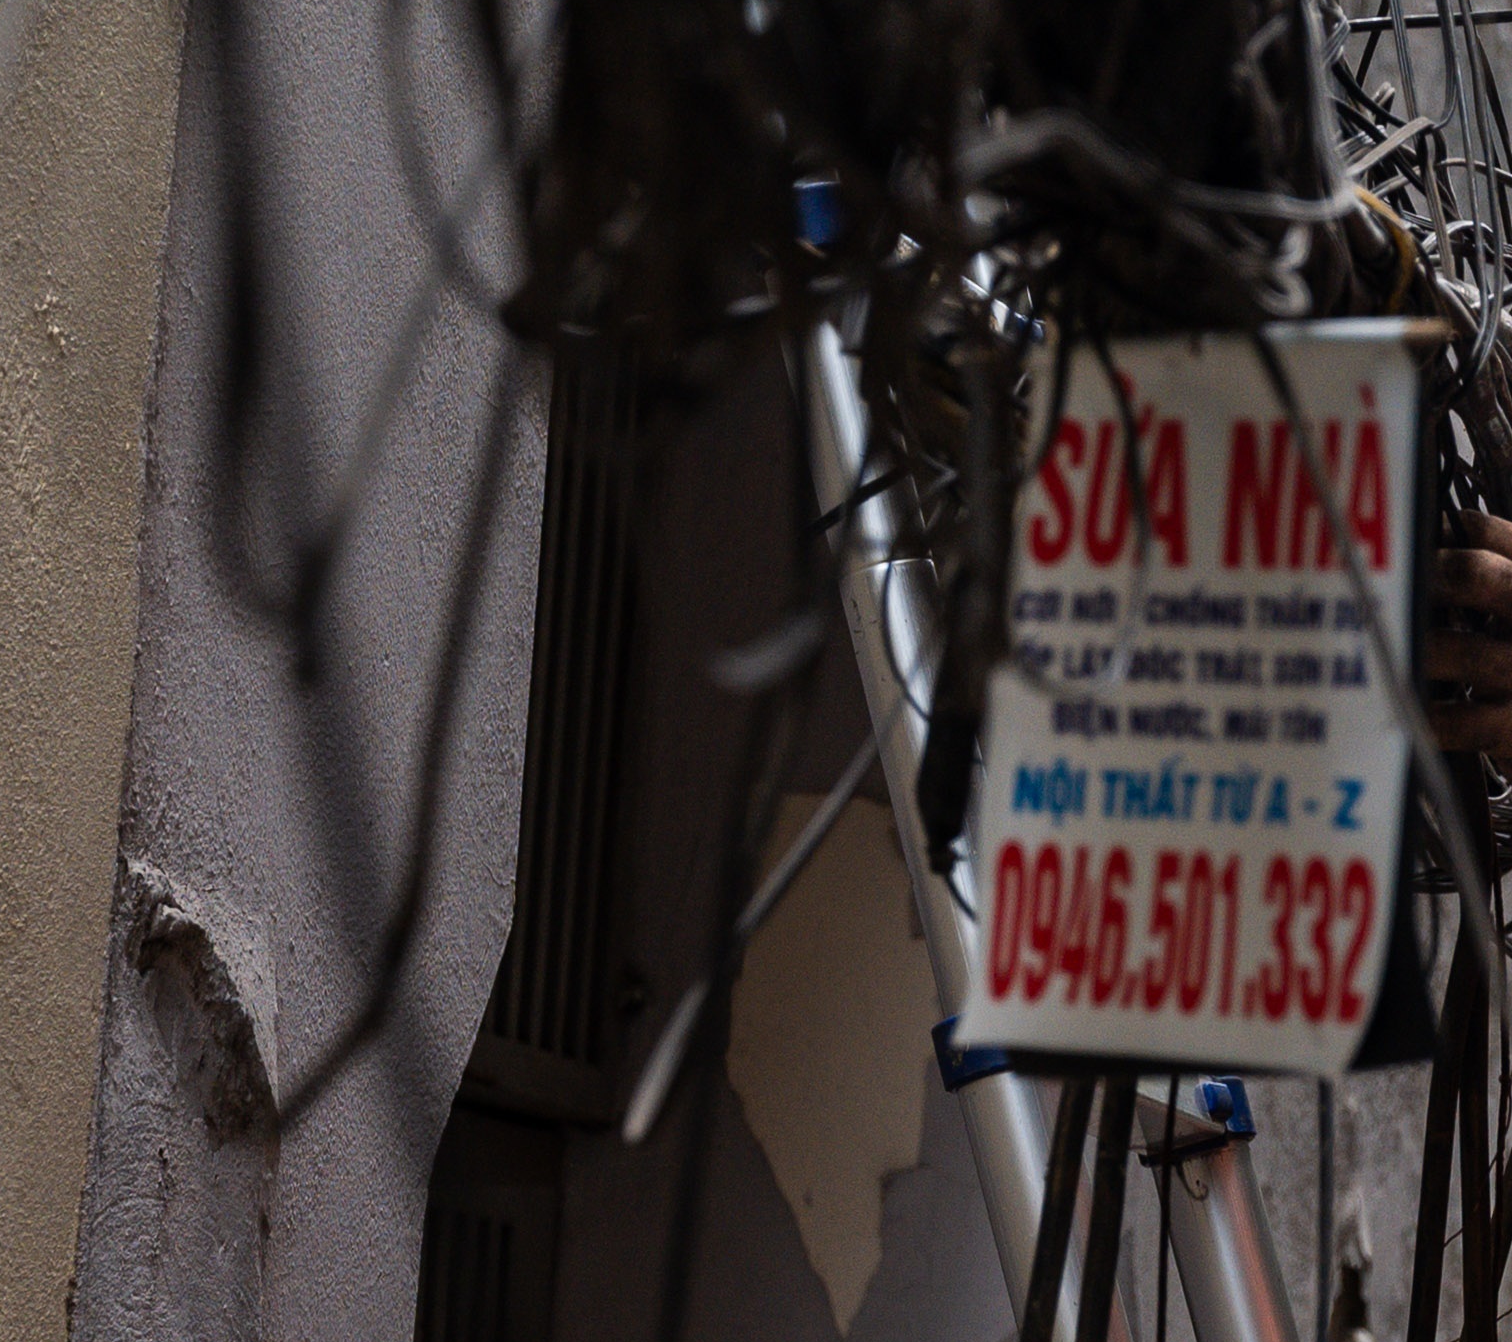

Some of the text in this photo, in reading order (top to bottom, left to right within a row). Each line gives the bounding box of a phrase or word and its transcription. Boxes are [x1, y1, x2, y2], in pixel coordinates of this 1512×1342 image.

[1224, 381, 1390, 569] NHÀ
[1013, 757, 1088, 826] NỘI
[1103, 754, 1198, 821] THẤT
[1212, 760, 1262, 824] TỪ
[1264, 778, 1290, 824] A
[1333, 779, 1366, 829] Z
[990, 841, 1374, 1021] 0946.501.332
